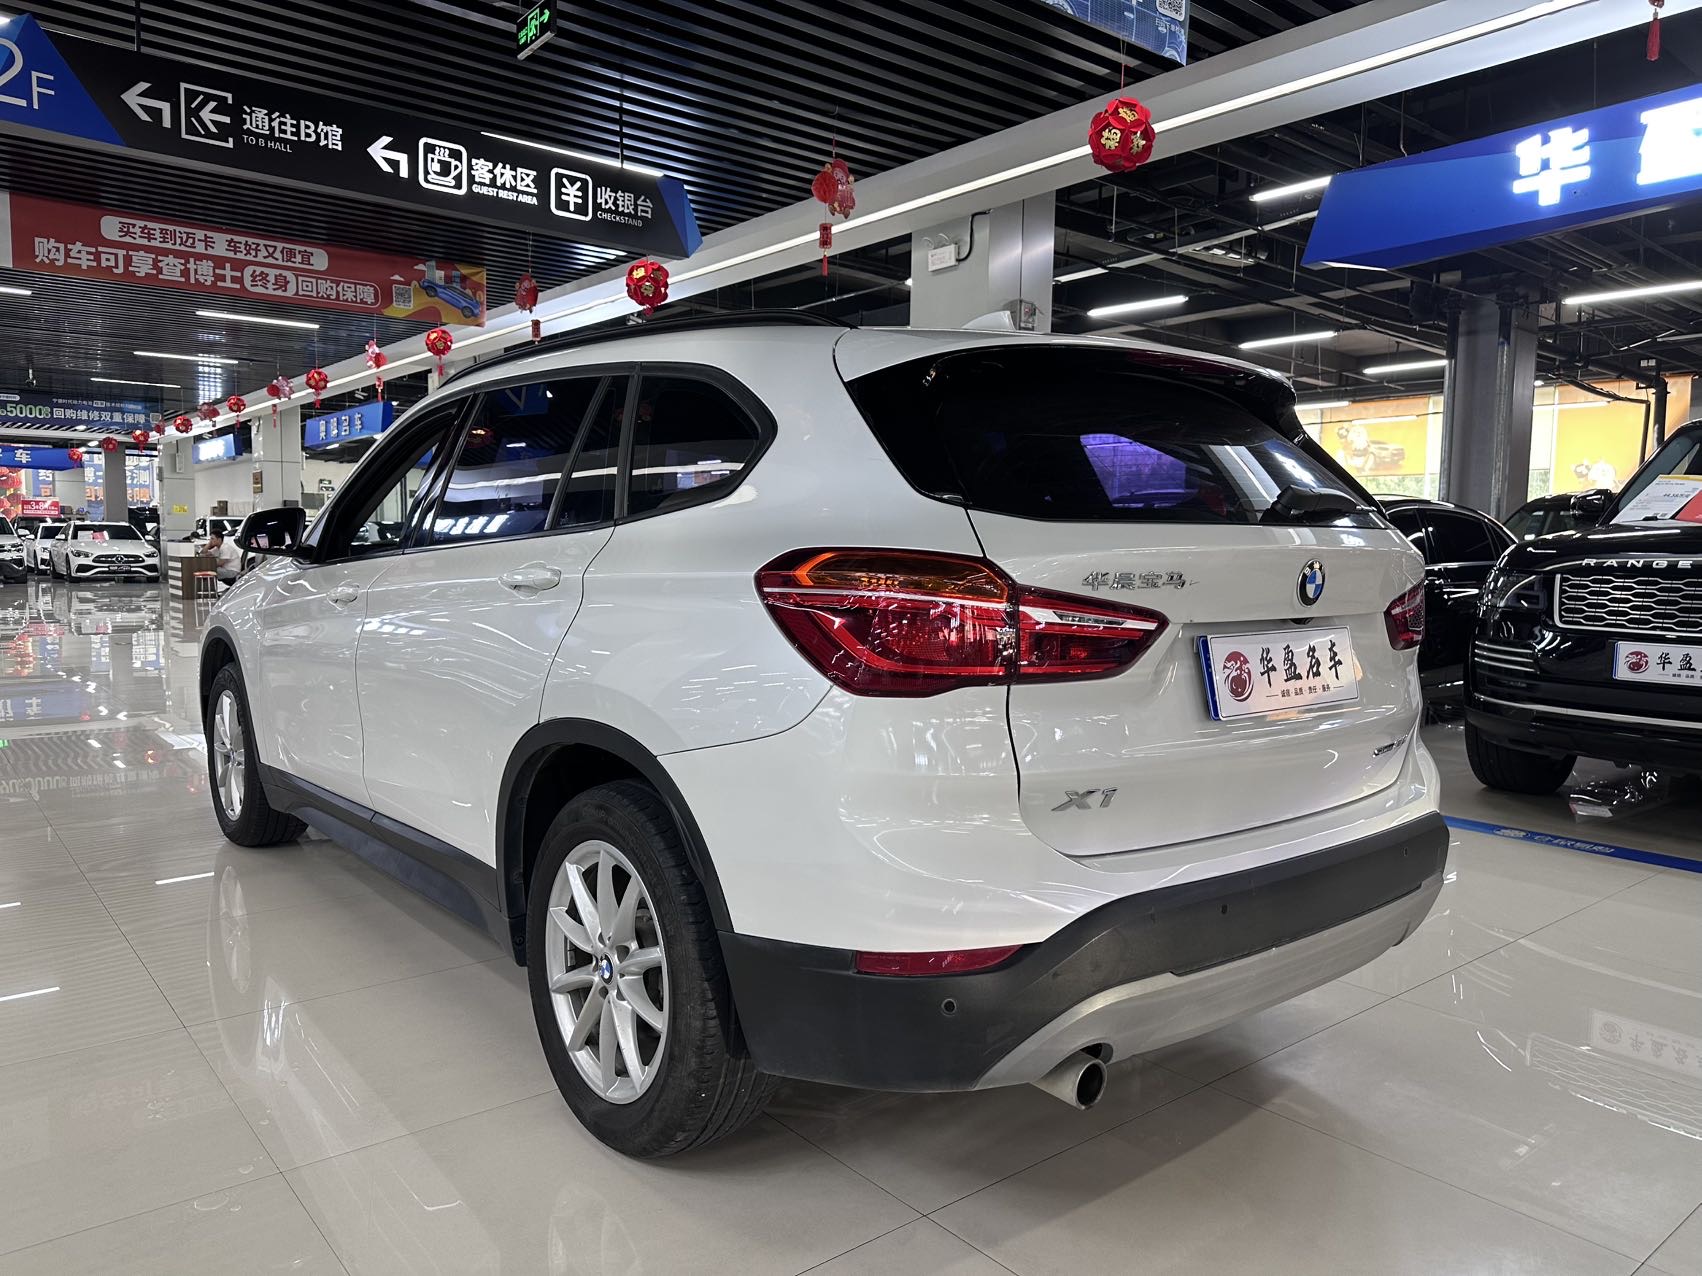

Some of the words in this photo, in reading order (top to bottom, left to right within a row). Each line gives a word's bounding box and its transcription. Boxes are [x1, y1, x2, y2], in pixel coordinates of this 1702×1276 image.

[242, 105, 343, 151] 通往B馆
[243, 135, 256, 145] TO
[258, 138, 265, 147] B
[267, 140, 293, 152] HALL
[471, 158, 538, 194] 客休区
[472, 184, 498, 197] GUEST
[498, 189, 518, 202] REST
[518, 193, 538, 205] AREA
[597, 186, 653, 219] 收银台
[597, 211, 643, 227] CHECKSTAND
[118, 221, 216, 251] 买车到迈卡
[225, 237, 314, 266] 车好又便宜
[34, 237, 242, 289] 购车可享查博士
[250, 269, 291, 293] 终身
[298, 276, 375, 305] 回购保障
[53, 408, 146, 424] 回购维修双重保障
[1582, 558, 1693, 569] RANGE
[1081, 570, 1186, 592] 华晨宝马
[1259, 639, 1343, 688] 华盈名车
[1656, 651, 1702, 673] 华盈
[1051, 787, 1118, 812] X1
